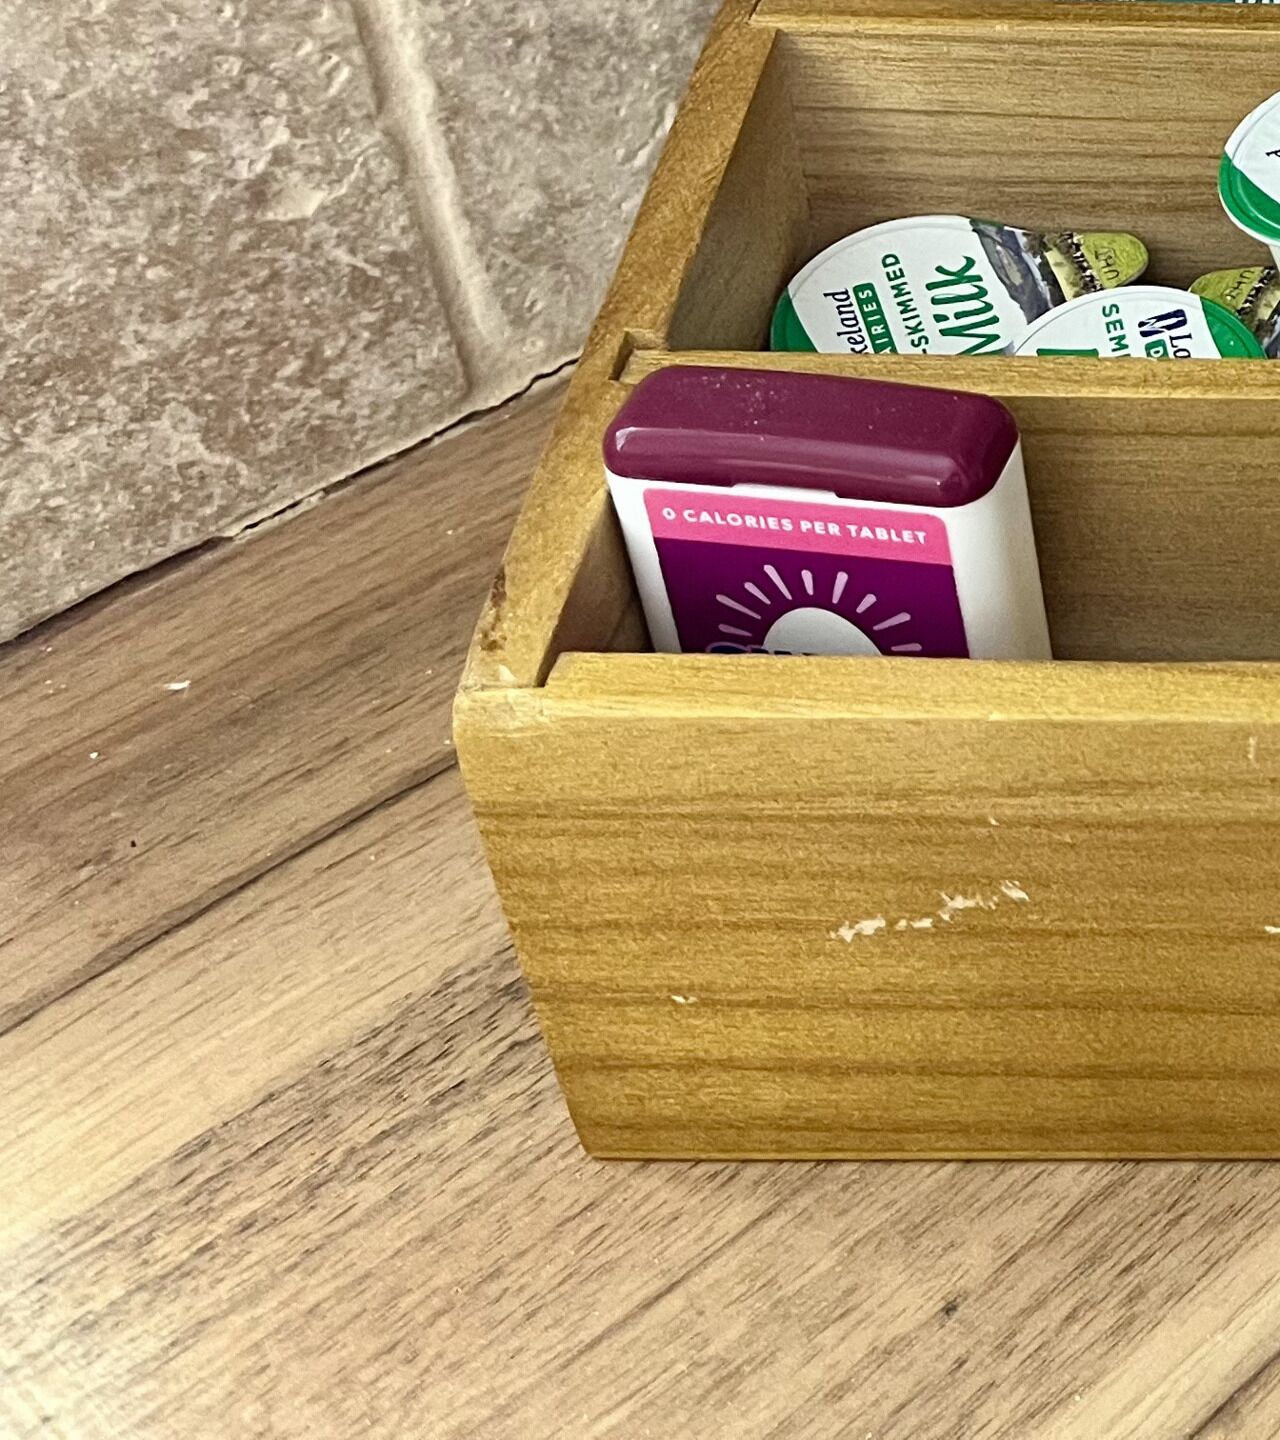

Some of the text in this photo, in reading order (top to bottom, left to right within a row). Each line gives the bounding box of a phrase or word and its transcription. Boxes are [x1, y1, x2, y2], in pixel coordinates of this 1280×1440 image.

[682, 509, 794, 532] CALORIES
[799, 519, 842, 537] PER
[846, 524, 927, 545] TABLET
